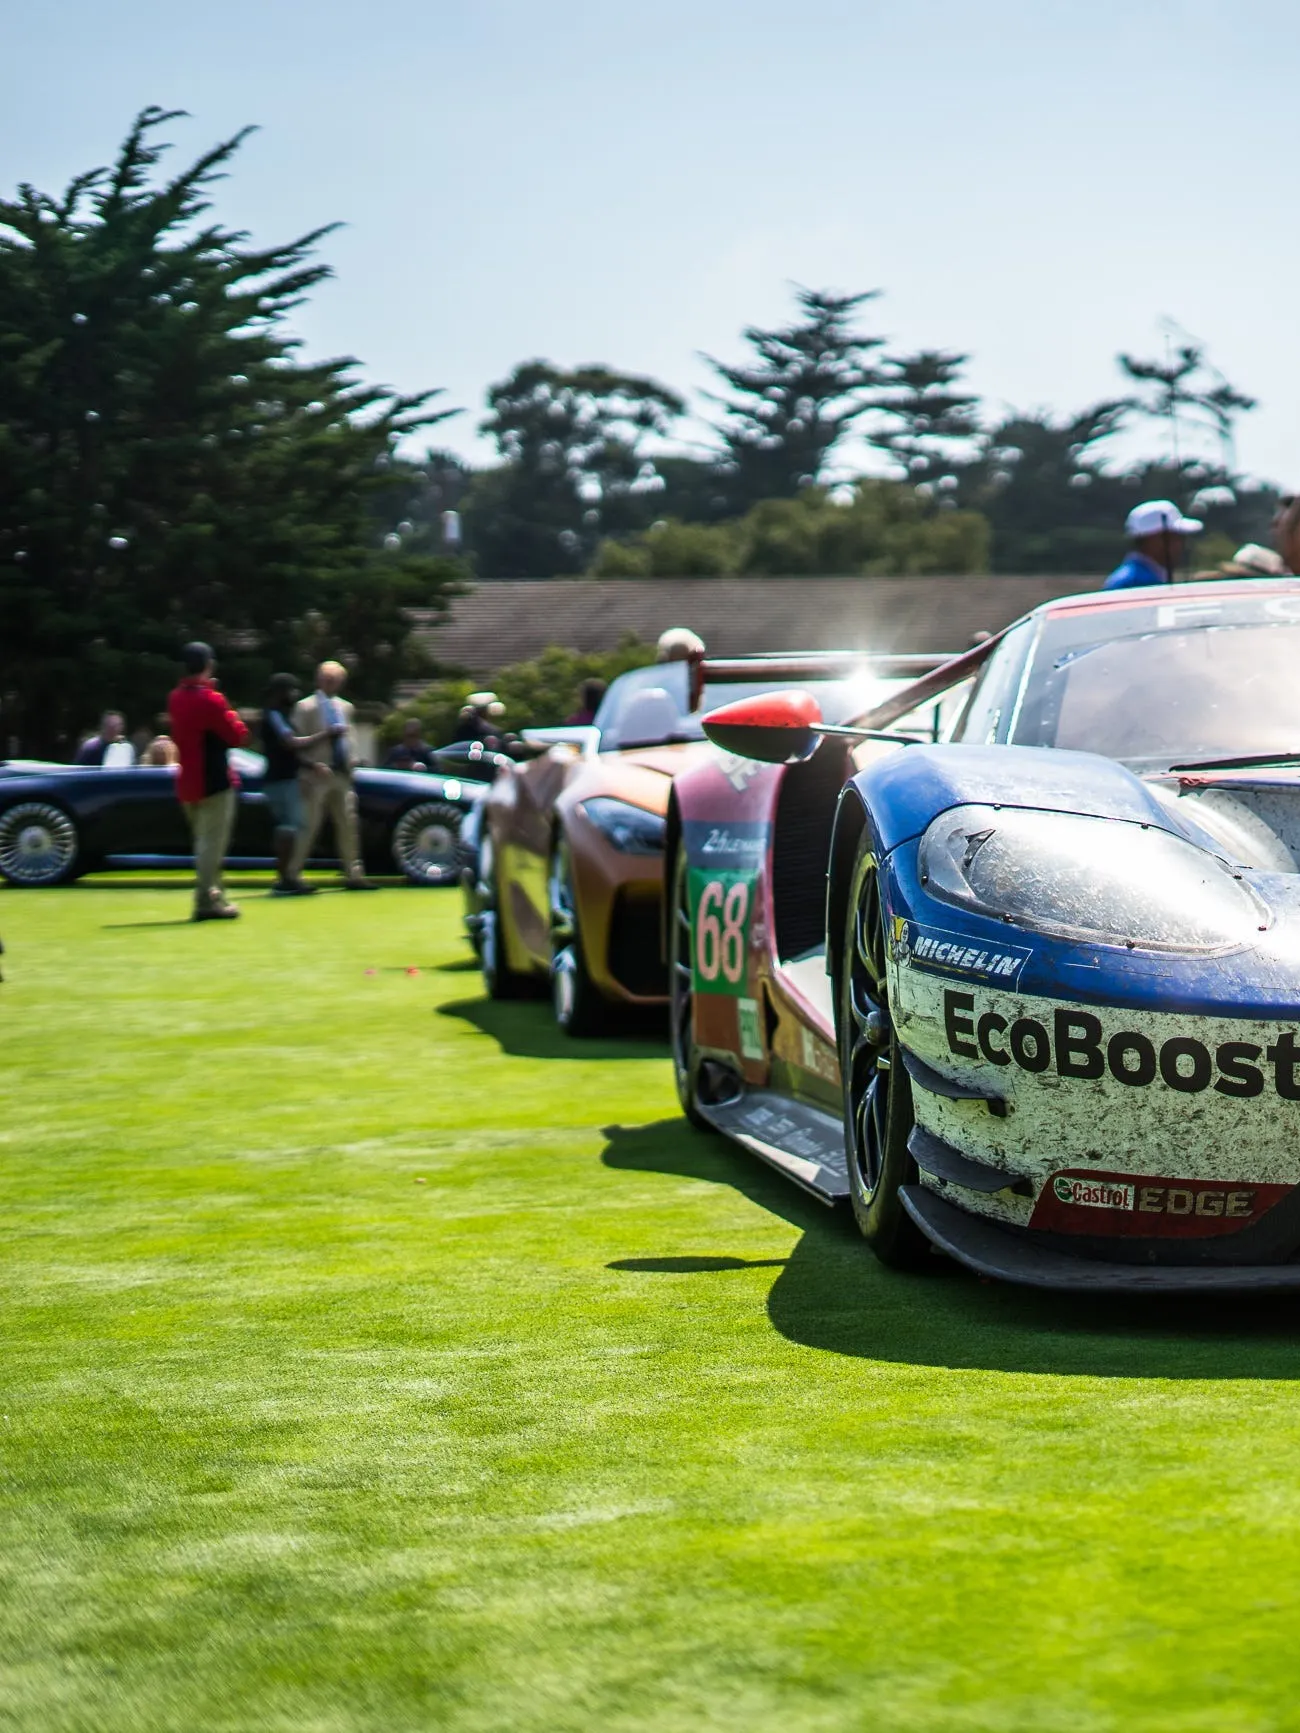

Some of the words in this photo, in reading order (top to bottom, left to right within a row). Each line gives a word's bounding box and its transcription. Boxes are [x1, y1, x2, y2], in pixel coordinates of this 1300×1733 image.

[697, 881, 749, 985] 68
[914, 936, 1022, 977] MICHELIN
[1072, 1182, 1130, 1208] Castrol
[1138, 1186, 1256, 1218] EDGE
